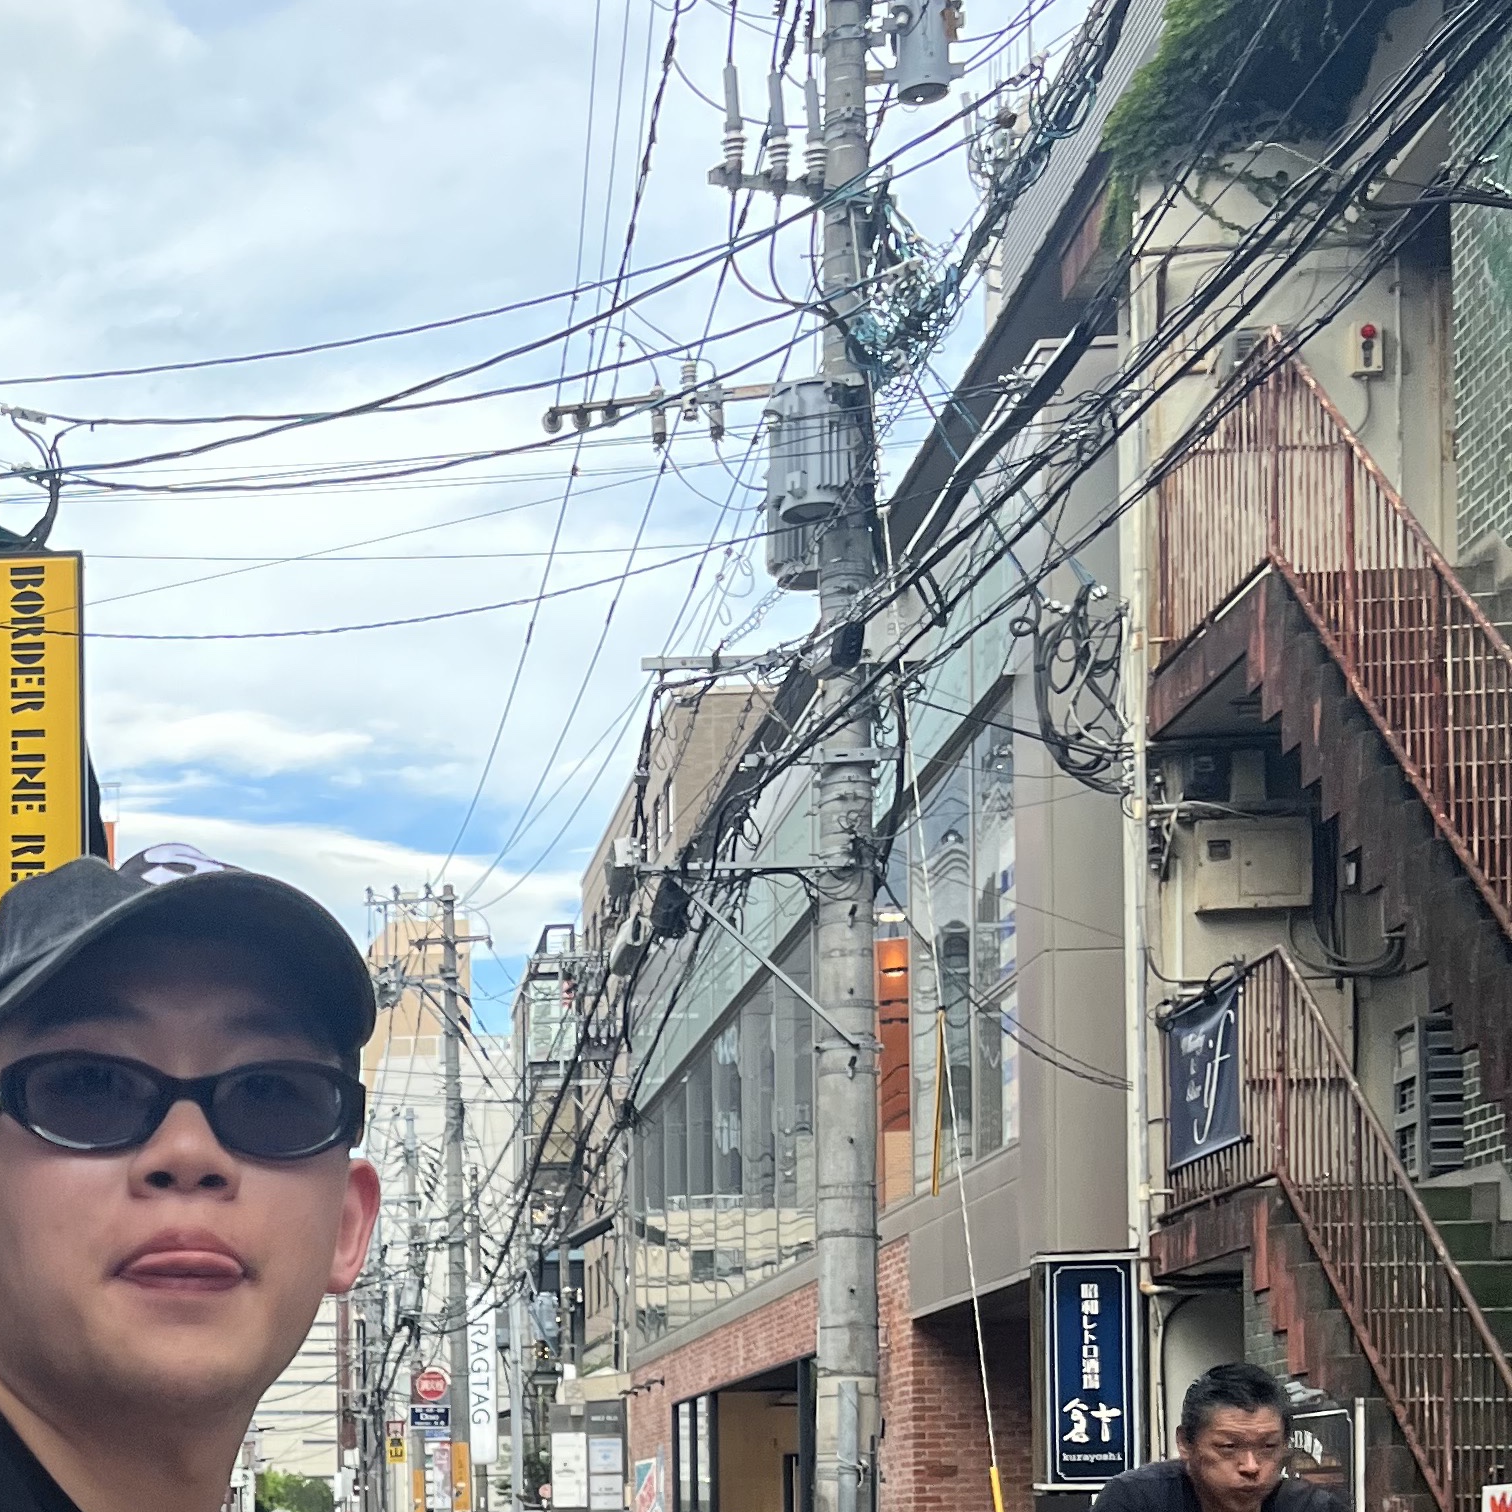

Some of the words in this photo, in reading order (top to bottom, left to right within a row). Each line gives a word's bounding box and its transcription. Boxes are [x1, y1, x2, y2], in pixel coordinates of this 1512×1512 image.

[9, 565, 46, 714] BORDER
[11, 729, 46, 815] LINE
[471, 1322, 491, 1425] RAGTAG
